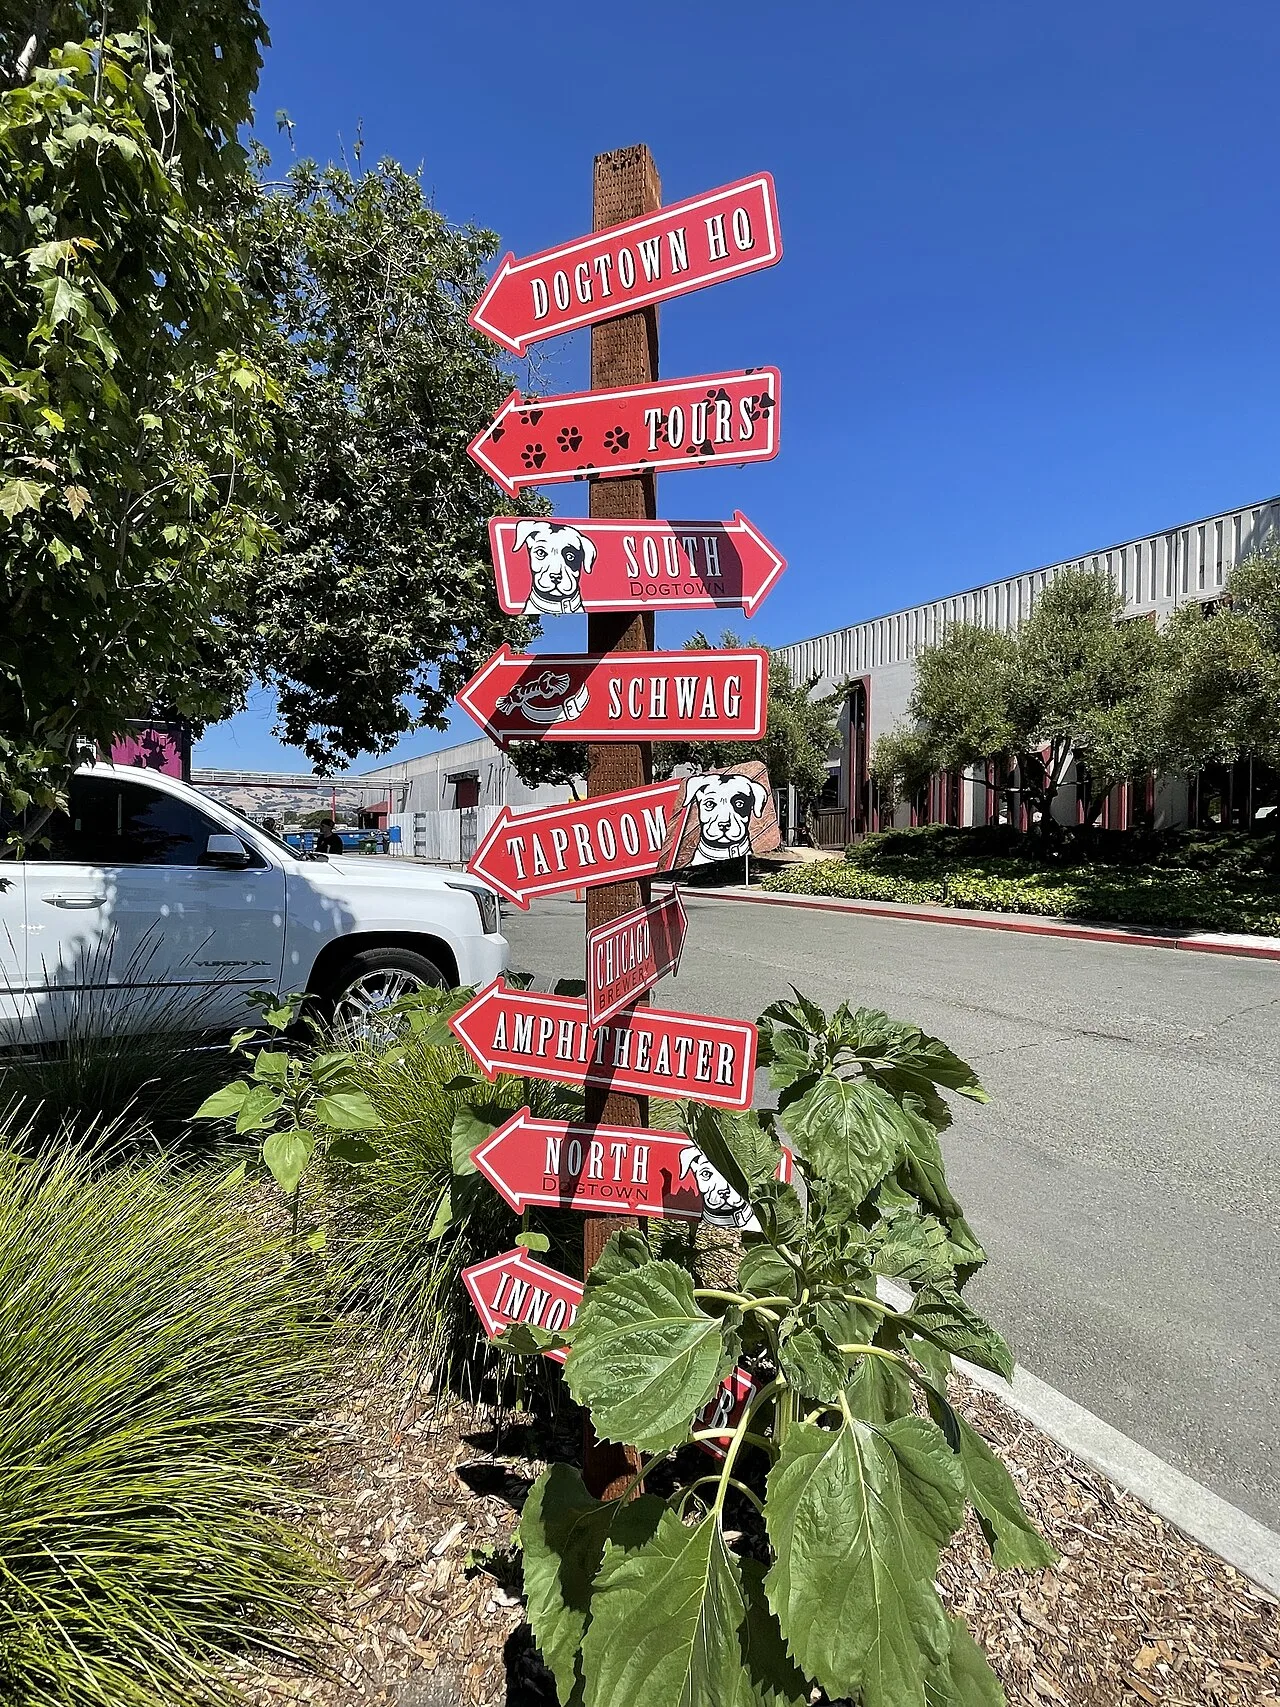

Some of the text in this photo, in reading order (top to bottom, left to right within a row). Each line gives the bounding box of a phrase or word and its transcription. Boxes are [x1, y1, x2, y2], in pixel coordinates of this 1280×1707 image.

[530, 207, 756, 320] DOGTOWN HQ
[644, 396, 754, 451] TOURS
[622, 535, 723, 578] SOUTH
[608, 675, 742, 720] SCHWAG
[506, 805, 667, 880] TAPROOM
[597, 919, 650, 990] CHICAGO
[599, 962, 650, 1010] BREWERY
[491, 1011, 737, 1086] AMPHITHEATER
[544, 1136, 651, 1184] NORTH
